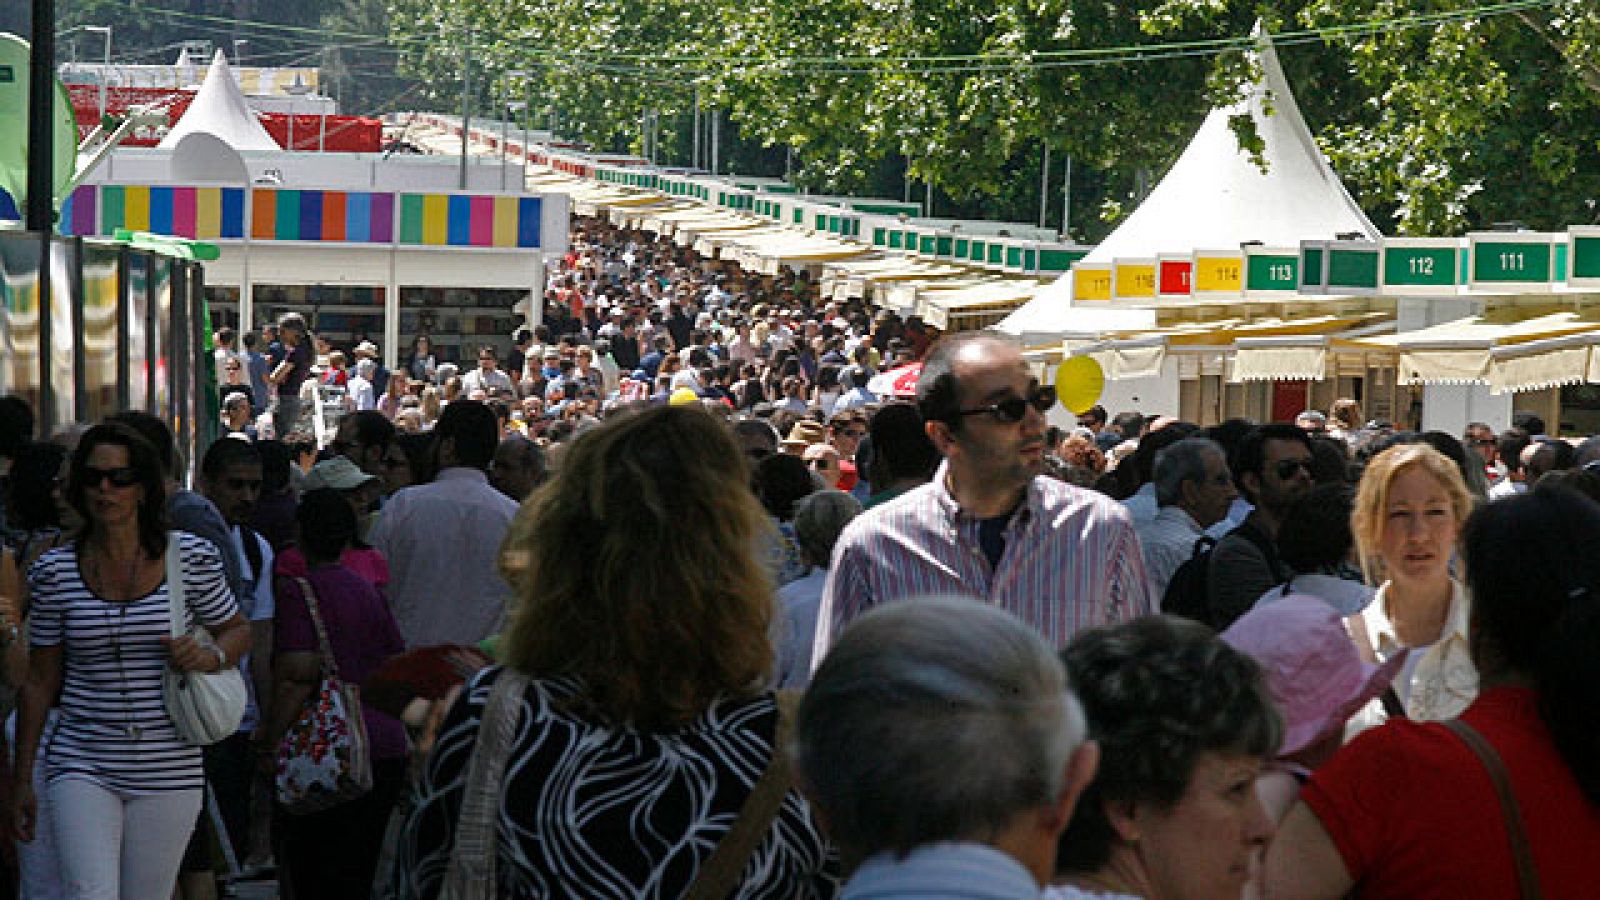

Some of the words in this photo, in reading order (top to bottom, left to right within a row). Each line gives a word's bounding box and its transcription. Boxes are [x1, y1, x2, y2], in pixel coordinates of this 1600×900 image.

[1409, 256, 1434, 275] 112
[1500, 252, 1524, 271] 111
[1269, 264, 1292, 281] 113
